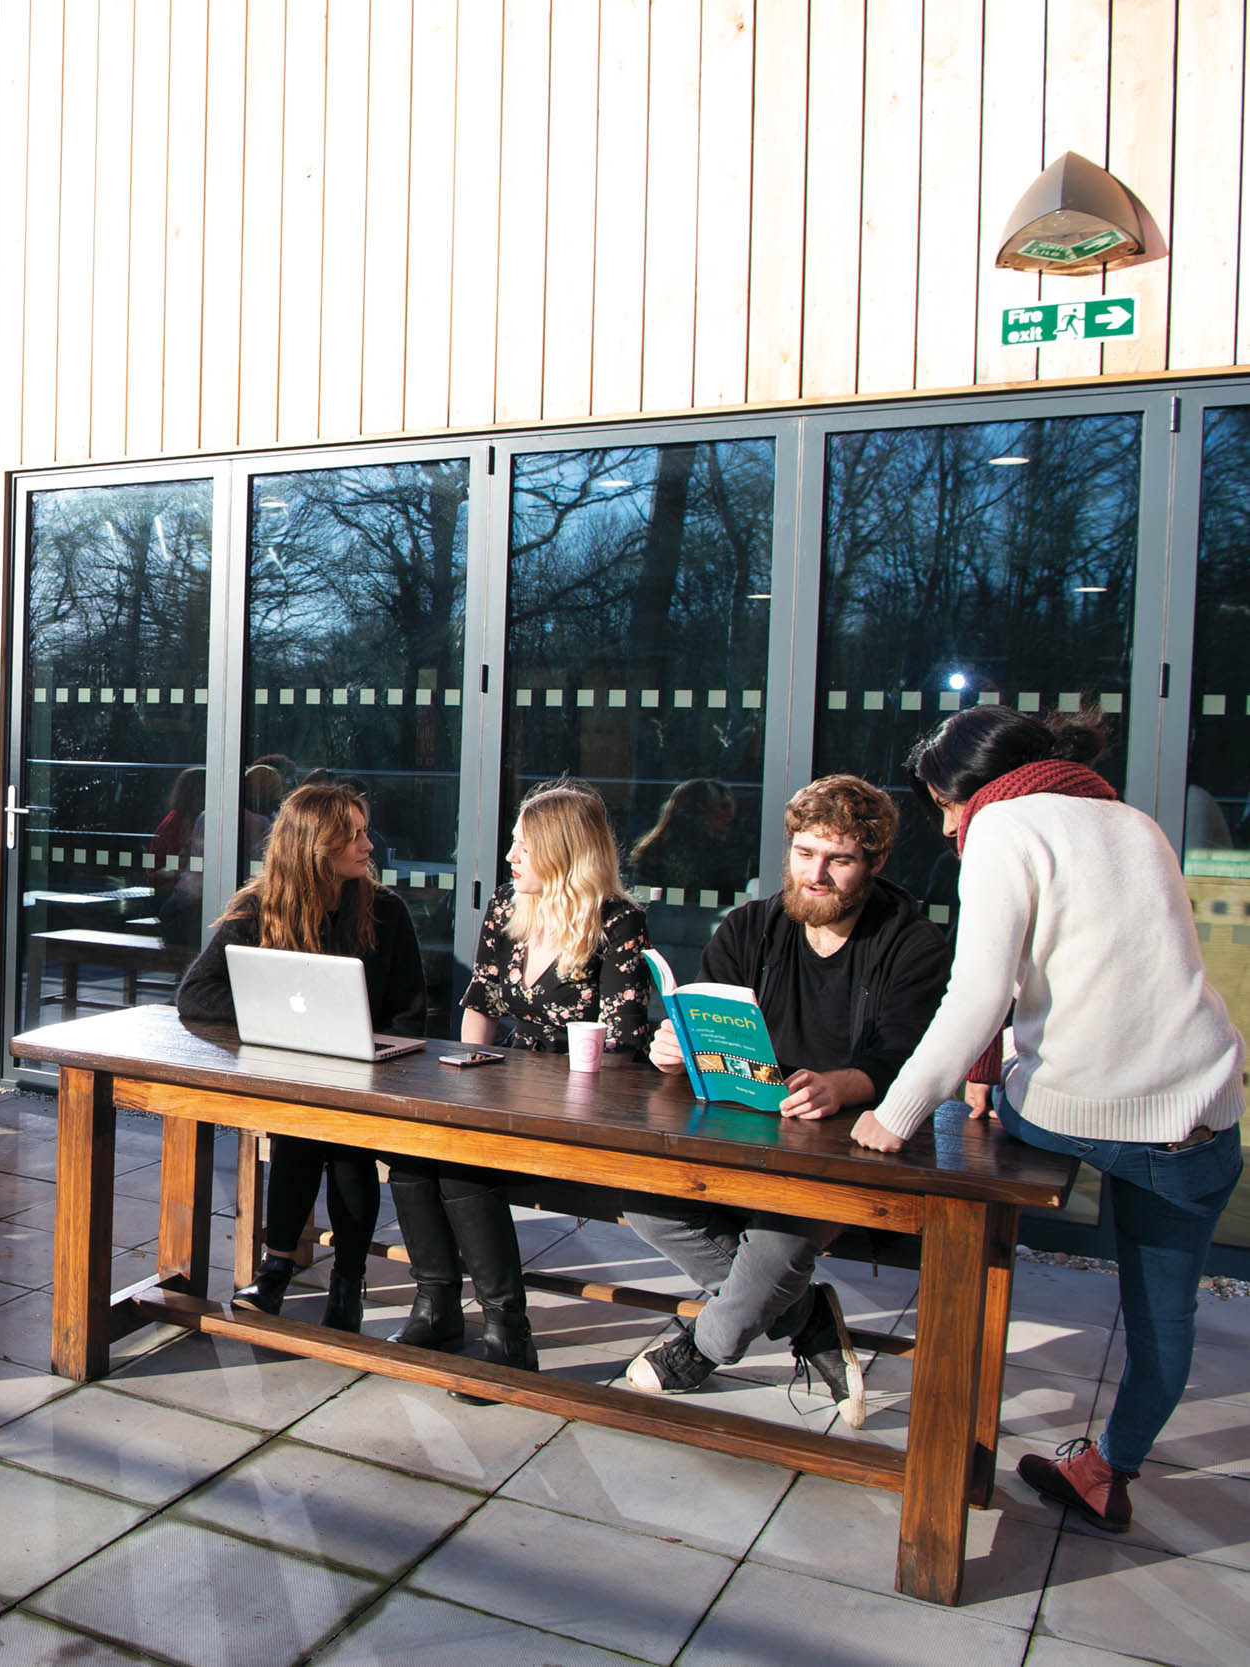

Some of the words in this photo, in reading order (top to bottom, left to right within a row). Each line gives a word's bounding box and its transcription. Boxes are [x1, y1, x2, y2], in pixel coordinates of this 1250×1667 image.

[1008, 309, 1043, 325] Fire
[1007, 326, 1043, 343] exit
[689, 1008, 757, 1031] French
